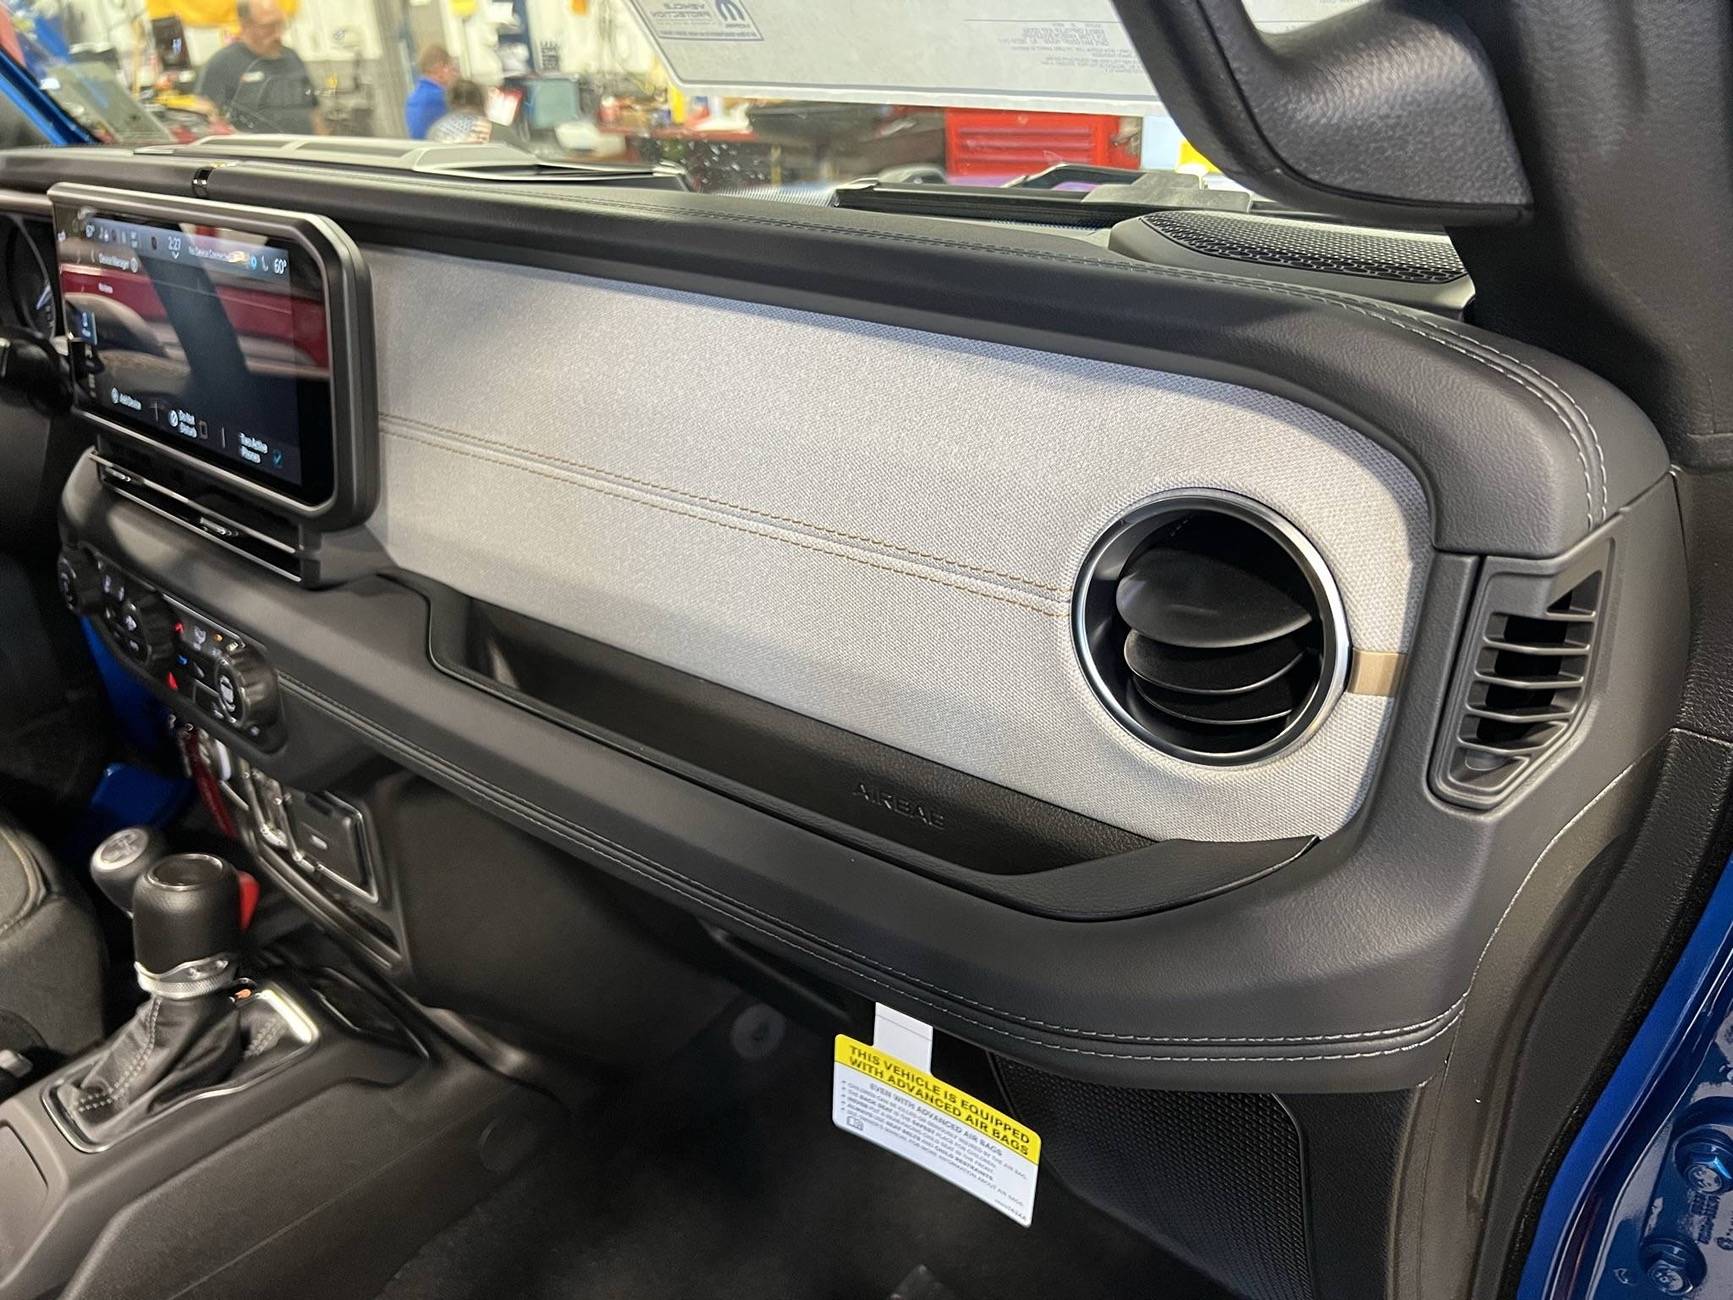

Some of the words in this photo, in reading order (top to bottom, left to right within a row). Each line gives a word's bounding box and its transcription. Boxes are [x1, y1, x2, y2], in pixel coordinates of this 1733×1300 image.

[852, 784, 944, 831] AIRBAG
[849, 1044, 879, 1065] THIS
[884, 1060, 940, 1095] VEHICLE
[944, 1090, 956, 1103] IS
[961, 1099, 1029, 1144] EQUIPPED
[849, 1055, 883, 1079] WITH
[887, 1073, 961, 1117] ADVANCED
[965, 1113, 988, 1132] AIR
[992, 1127, 1028, 1155] BAGS
[870, 1082, 891, 1098] EVEN
[894, 1093, 915, 1109] WITH
[916, 1105, 961, 1133] ADVANCED
[963, 1129, 977, 1142] AIR
[979, 1138, 1002, 1156] BAGS
